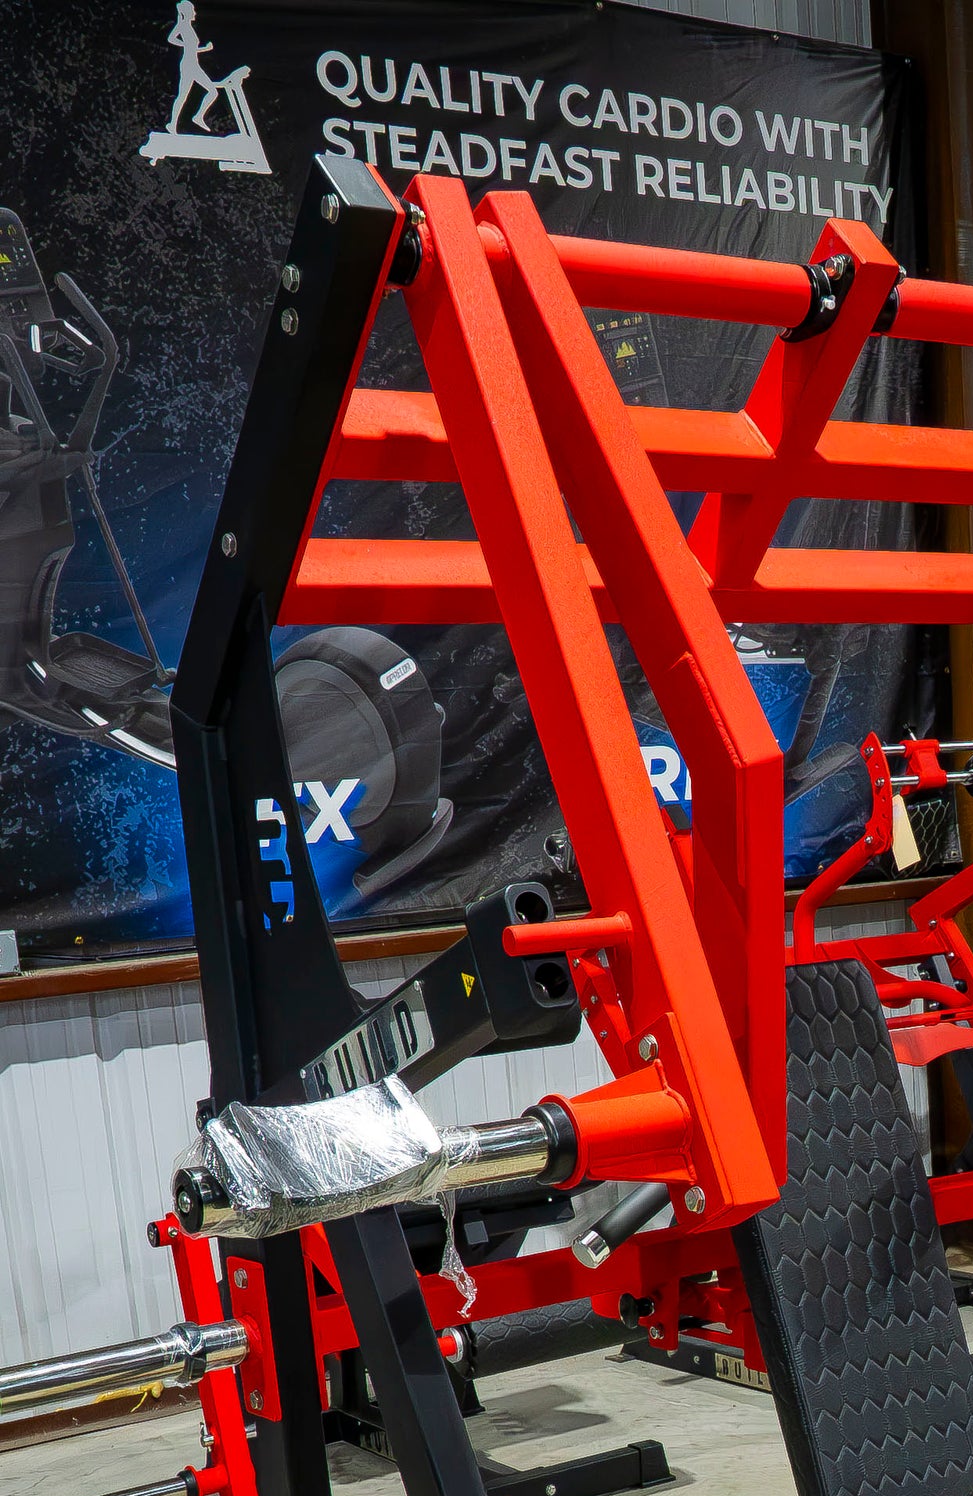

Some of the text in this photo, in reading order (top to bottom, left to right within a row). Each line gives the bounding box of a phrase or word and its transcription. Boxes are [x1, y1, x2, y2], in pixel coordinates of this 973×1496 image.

[316, 50, 869, 166] QUALITY CARDIO WITH
[322, 117, 893, 224] STEADFAST RELIABILITY
[312, 999, 419, 1100] BUILD
